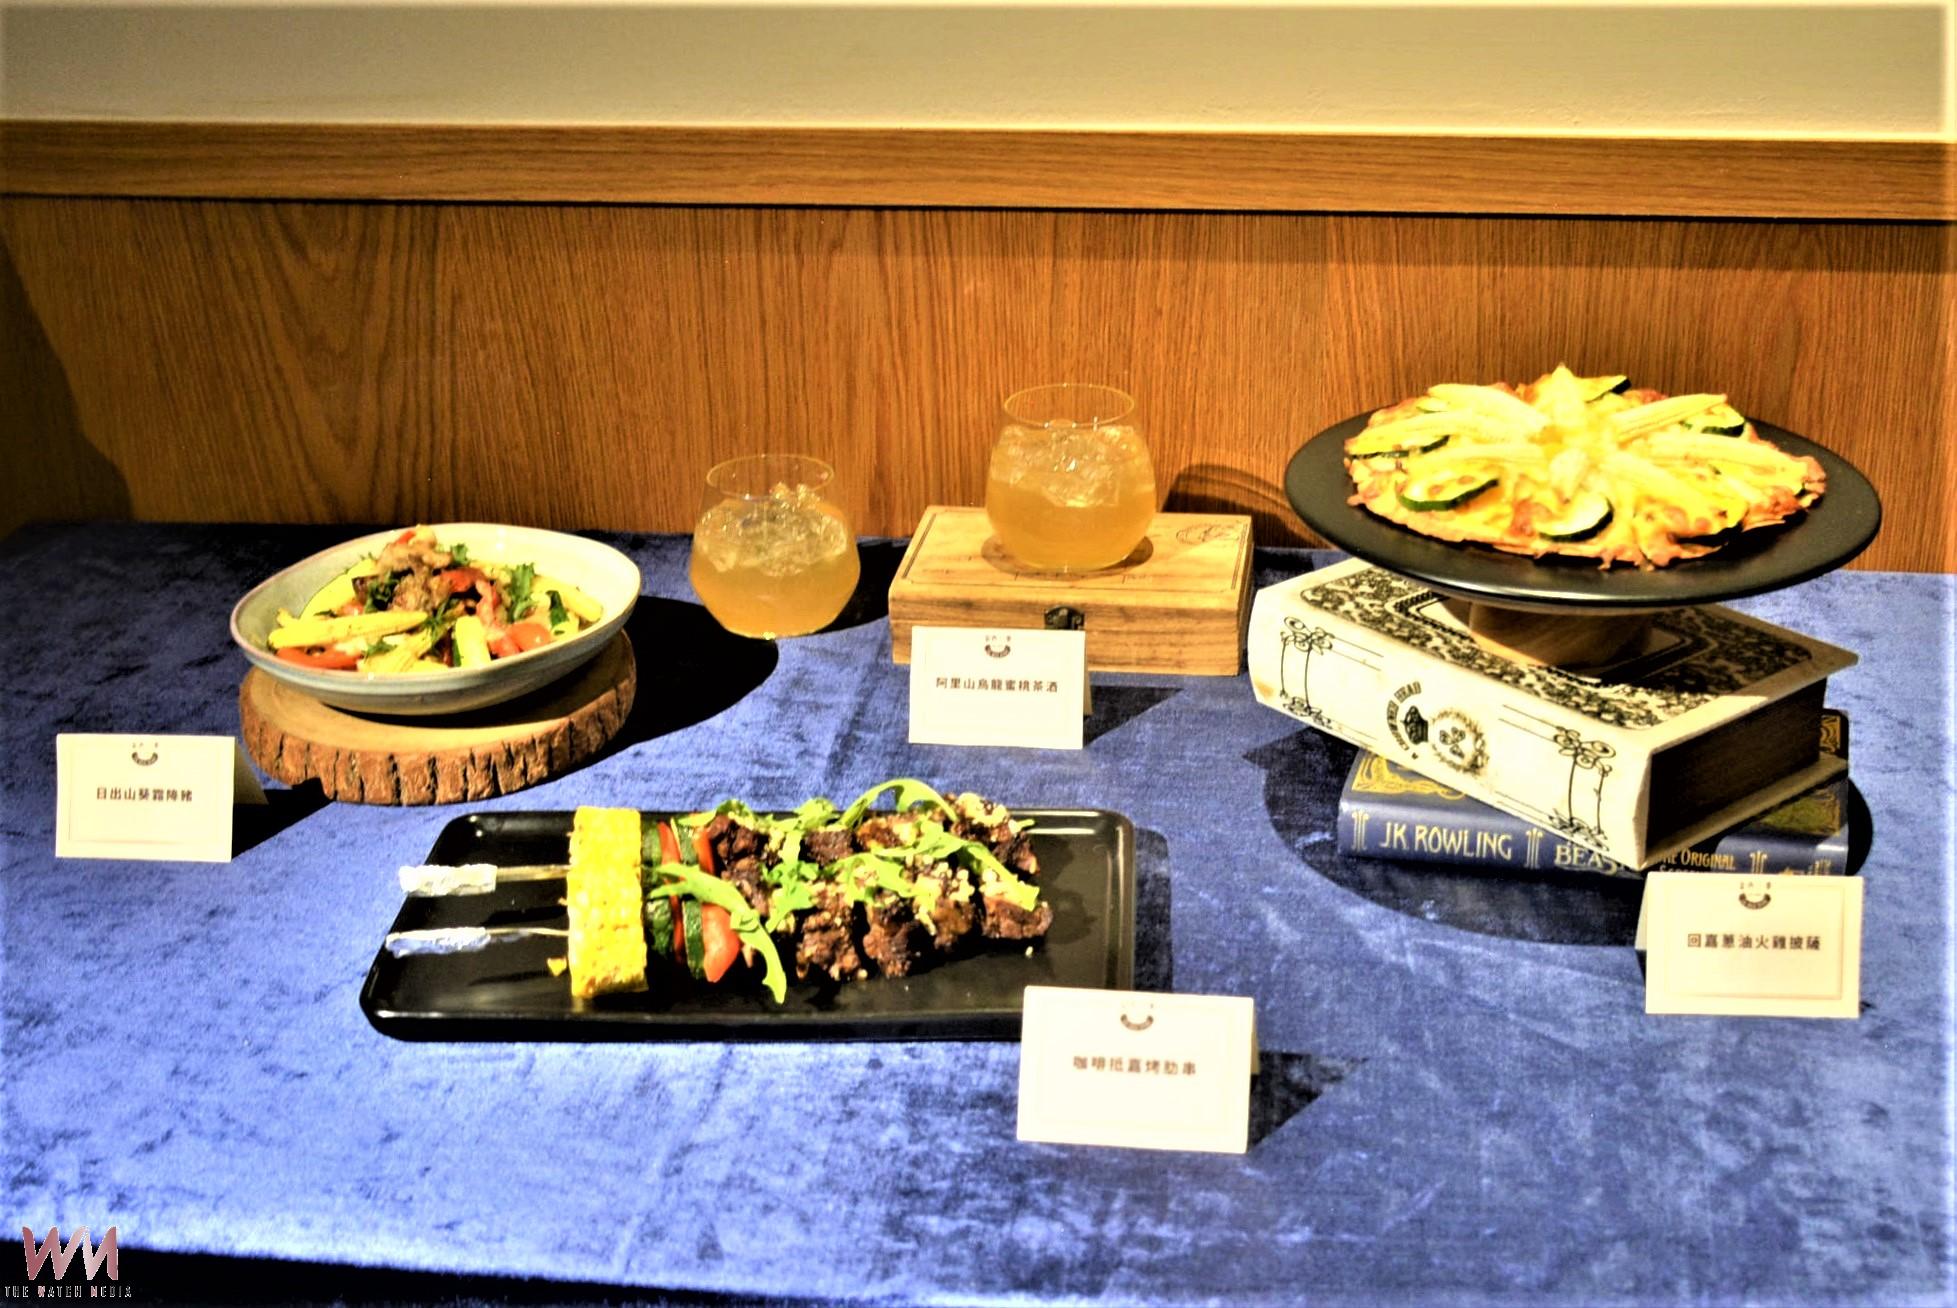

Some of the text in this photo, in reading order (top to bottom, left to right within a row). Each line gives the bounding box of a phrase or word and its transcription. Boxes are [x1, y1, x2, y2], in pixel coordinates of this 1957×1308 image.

[936, 677, 1058, 693] 阿里山烏龍蜜桃茶酒
[1414, 824, 1513, 861] ROWLING
[1680, 849, 1737, 870] ORIGINAL
